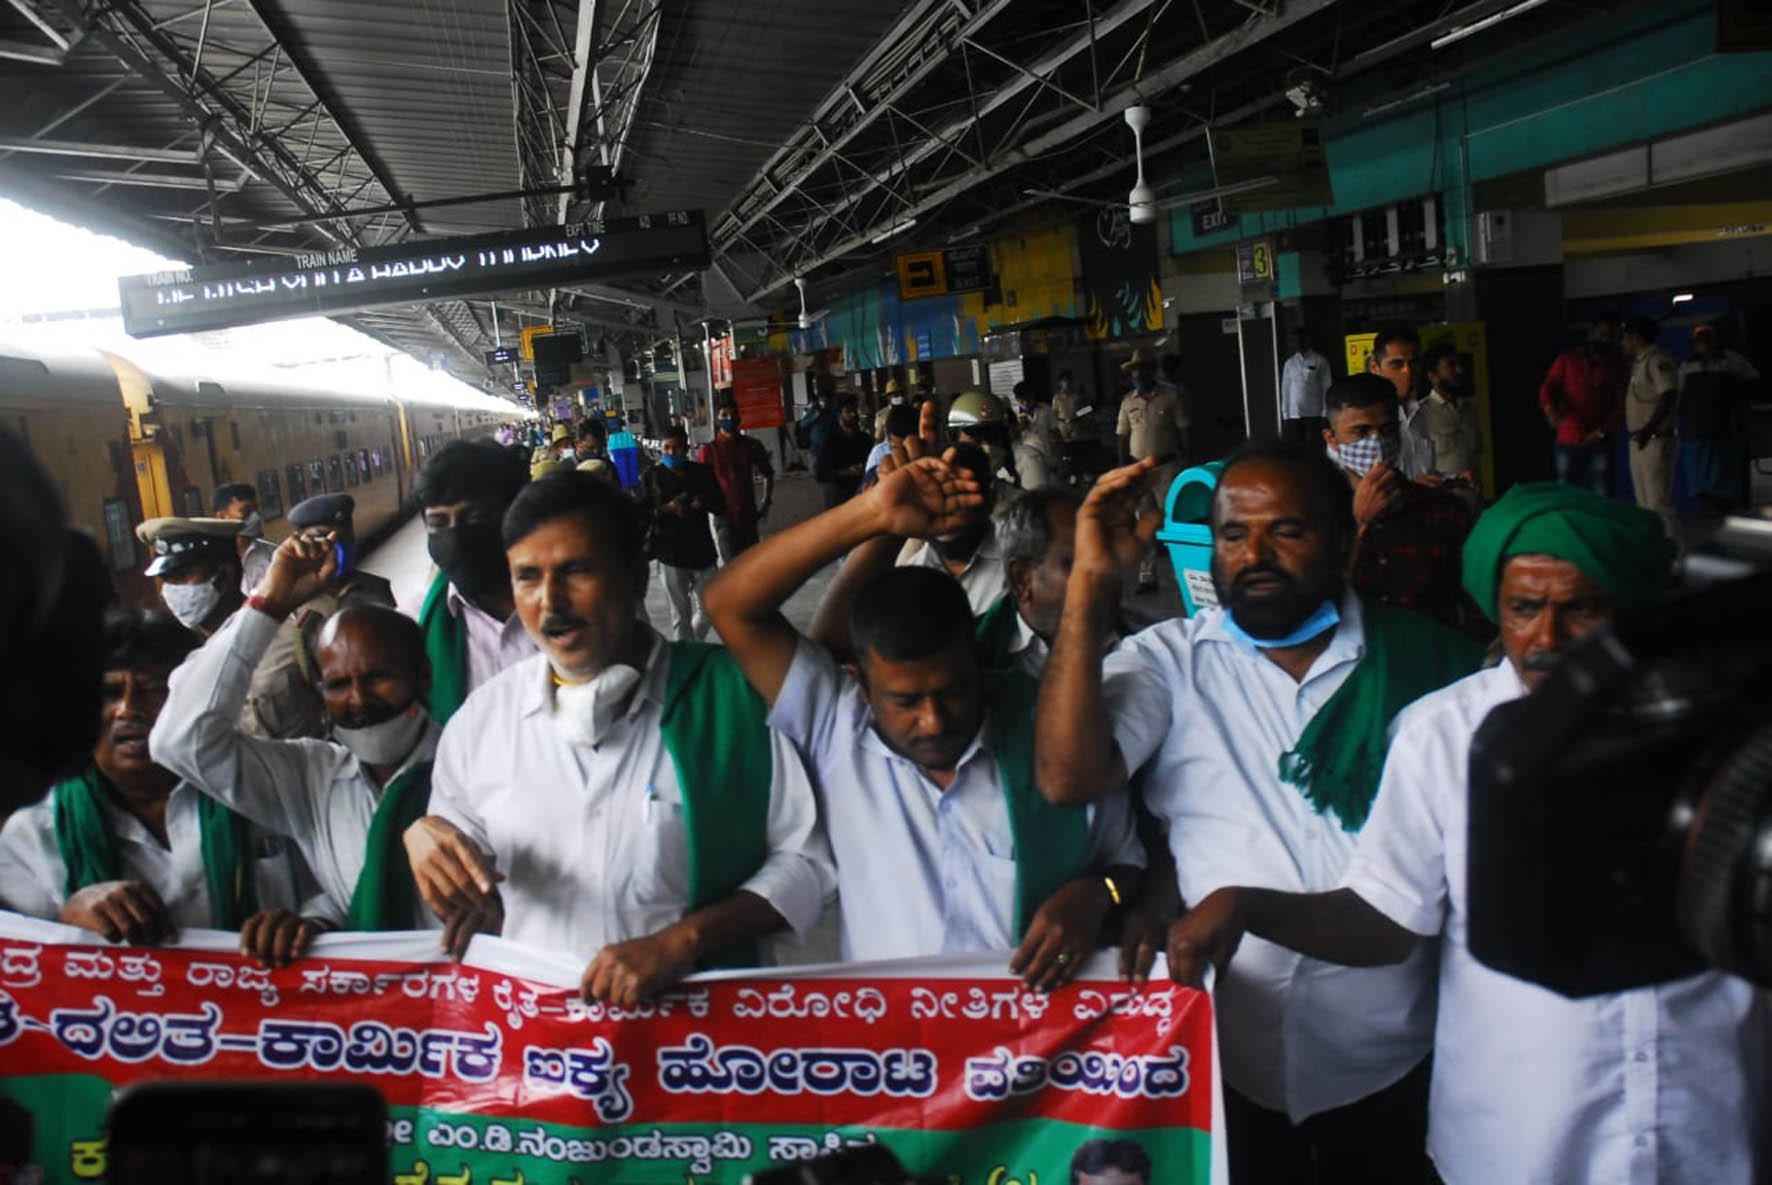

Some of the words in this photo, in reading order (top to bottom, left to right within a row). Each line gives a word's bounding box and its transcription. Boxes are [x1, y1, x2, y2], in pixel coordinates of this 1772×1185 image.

[297, 252, 327, 271] TRAIN
[329, 248, 359, 266] NAME
[1255, 246, 1267, 274] 3
[147, 271, 176, 286] TRAIN
[0, 943, 43, 988] ದ್ರ
[63, 949, 165, 997] ಮತ್ತು
[186, 961, 281, 1007] ರಾಜ್ಯ
[299, 964, 481, 1004] ಸರ್ಕಾರಗಳ
[731, 984, 889, 1024] ವಿರೋಧಿ
[911, 986, 1050, 1020] ನೀತಿಗಳ
[525, 1036, 633, 1124] ಐಕ್ಯ
[657, 1033, 937, 1099] ಹೋರಾಟ
